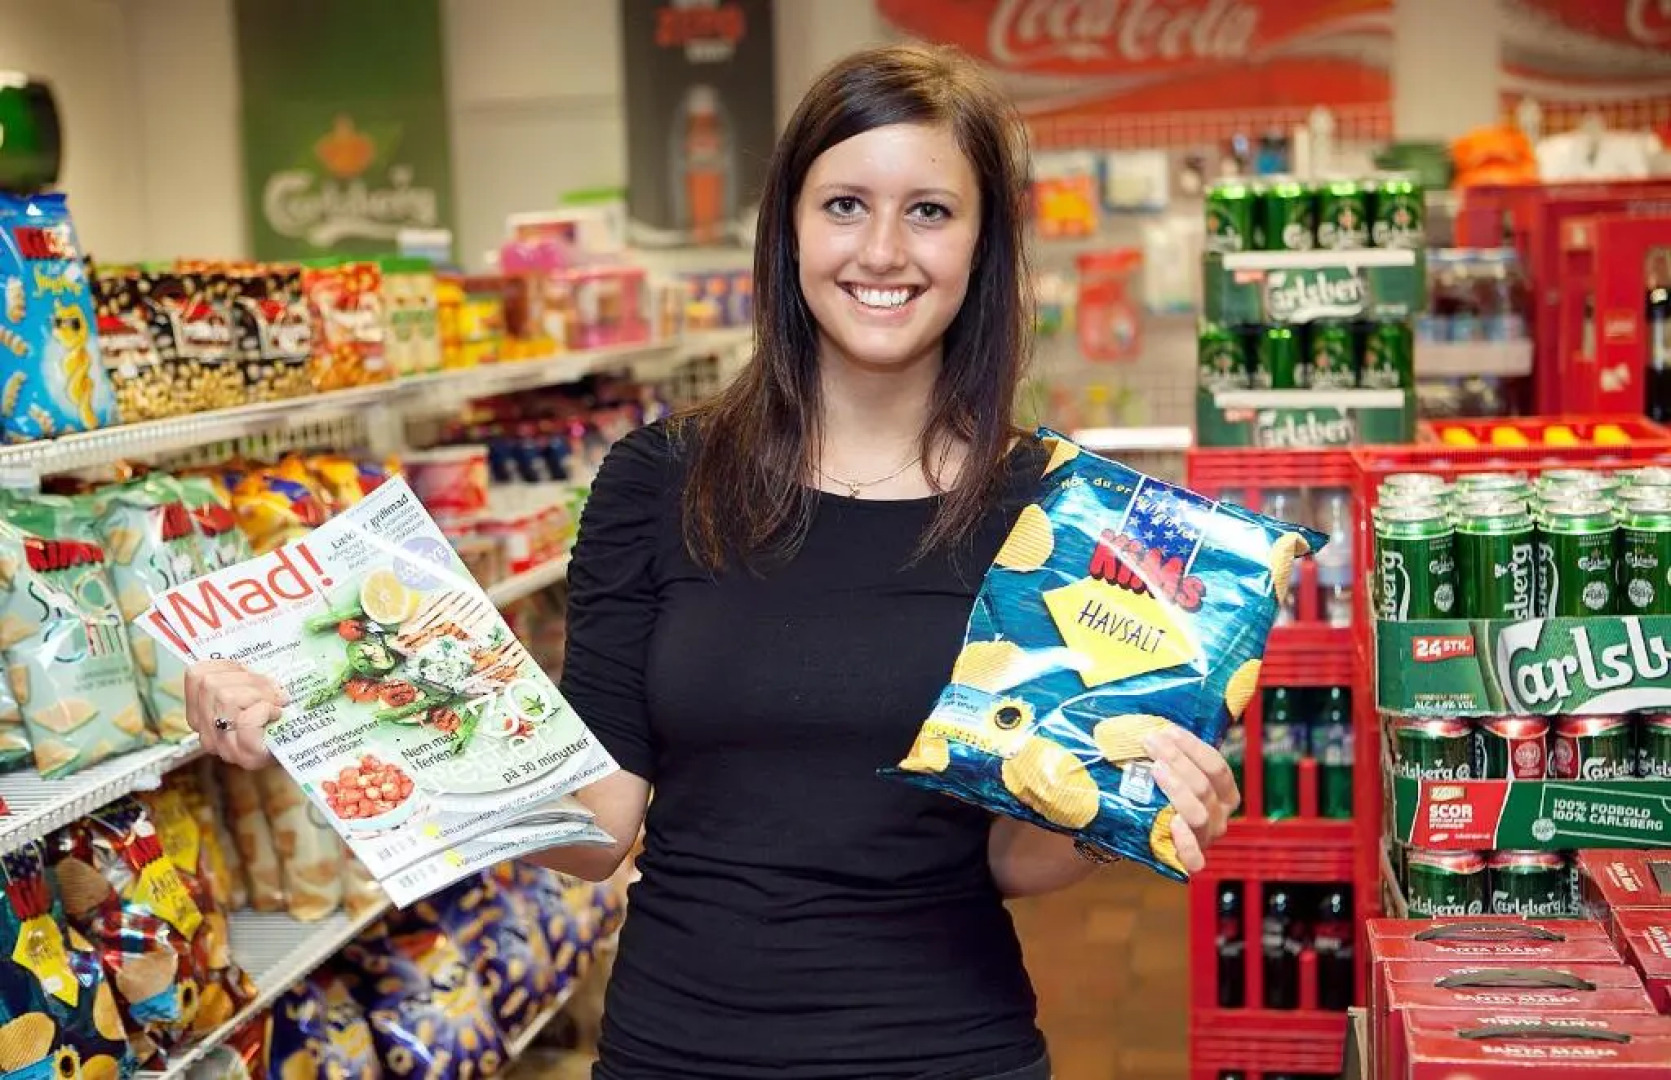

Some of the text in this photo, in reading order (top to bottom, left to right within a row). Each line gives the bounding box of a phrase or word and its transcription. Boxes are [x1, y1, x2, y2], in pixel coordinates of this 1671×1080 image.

[167, 543, 333, 639] Mad!
[1078, 600, 1166, 654] HAVSALT
[1416, 638, 1471, 657] 24 STK.
[288, 719, 380, 764] Sommerdesserter
[401, 729, 461, 761] Nem mad
[297, 756, 322, 772] med
[418, 747, 454, 770] ferien
[502, 737, 591, 785] på 30 minutter
[1429, 804, 1472, 818] SCOR
[1554, 799, 1651, 818] 100% FODBOLD
[1553, 810, 1664, 831] 100% CARLSBERG
